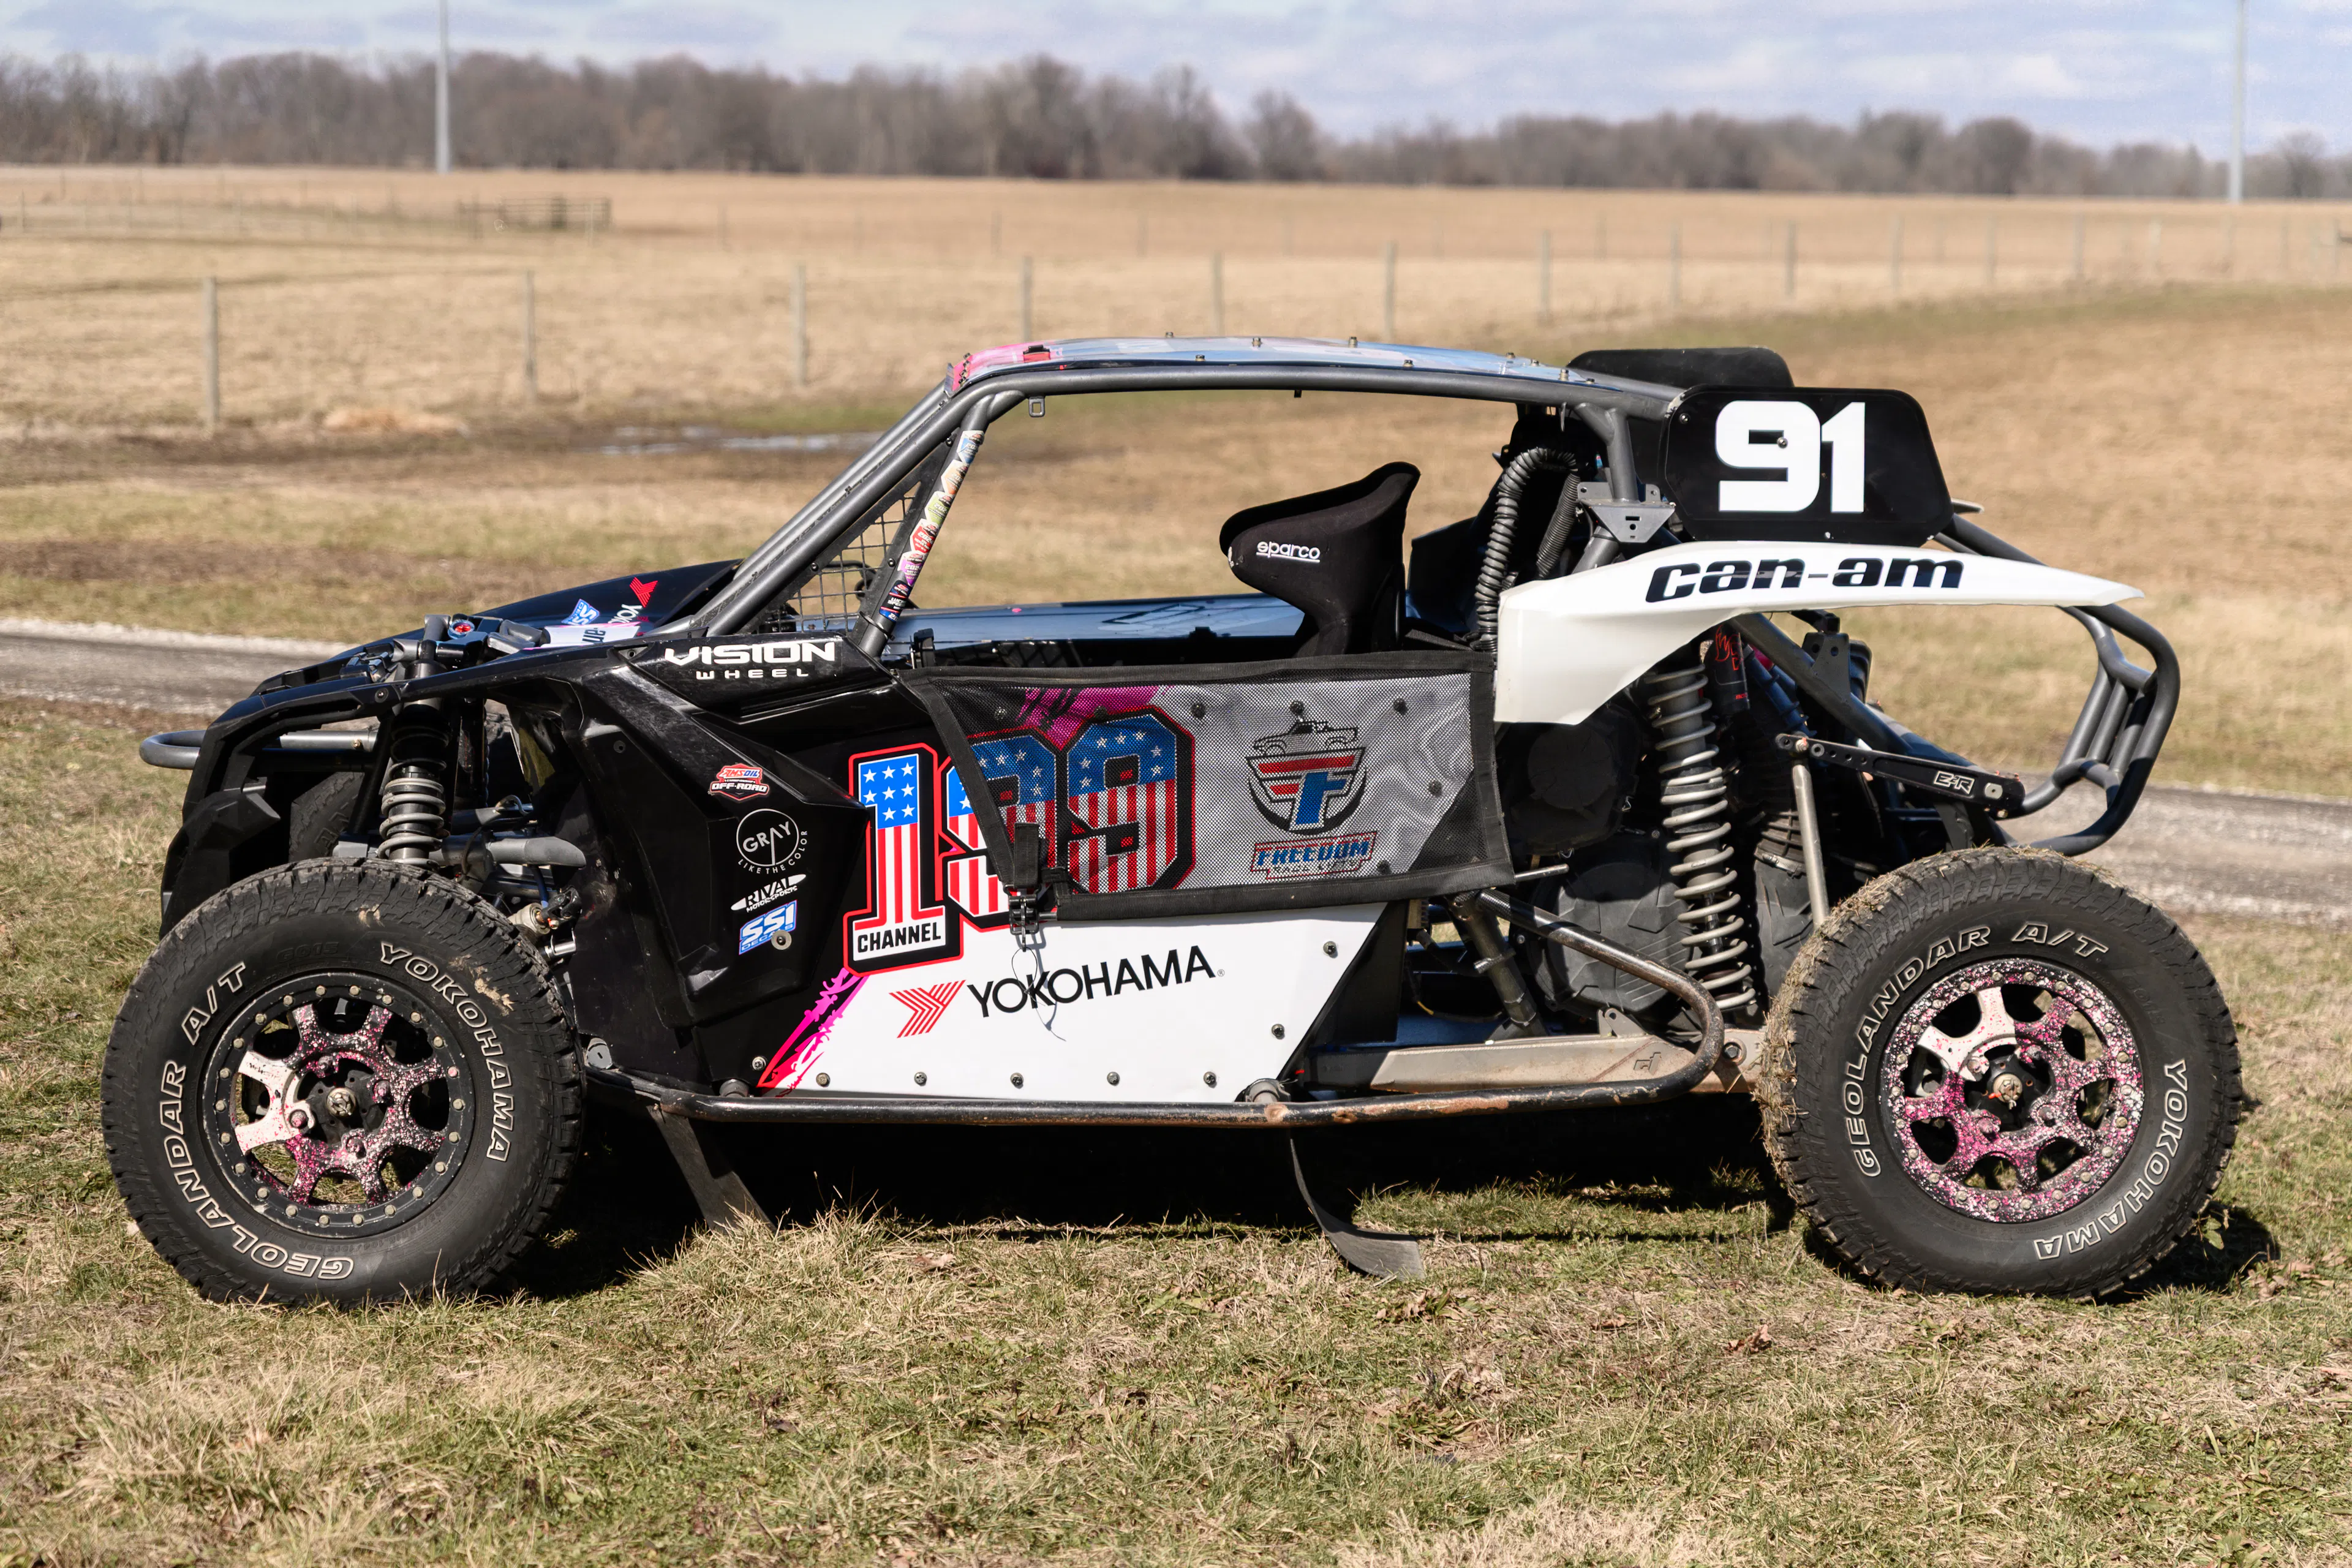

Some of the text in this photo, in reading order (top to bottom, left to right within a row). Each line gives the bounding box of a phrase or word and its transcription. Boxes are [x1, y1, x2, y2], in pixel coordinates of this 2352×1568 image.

[1716, 400, 1865, 514] 91
[1257, 541, 1321, 560] sparco
[1645, 557, 1964, 603] can-am
[665, 642, 835, 666] VISION
[696, 668, 809, 680] WHEEL
[720, 768, 760, 778] AMSOIL
[737, 831, 808, 875] LIKE THE COLOR
[742, 821, 791, 865] GRAY
[1257, 839, 1370, 866] FREEDOM
[745, 885, 798, 913] MOTORSPORTS
[746, 877, 794, 906] RIVAL
[741, 903, 794, 946] SSI
[741, 924, 794, 951] DECAS
[857, 921, 942, 954] CHANNEL
[276, 940, 341, 964] G015
[967, 945, 1216, 1018] YOKOHAMA
[380, 941, 514, 1163] YOKOHAMA
[1843, 923, 2110, 1177] GEOLANDAR A/T
[159, 961, 355, 1281] GEOLANDAR A/T
[2033, 1058, 2188, 1261] YOKOHAMA
